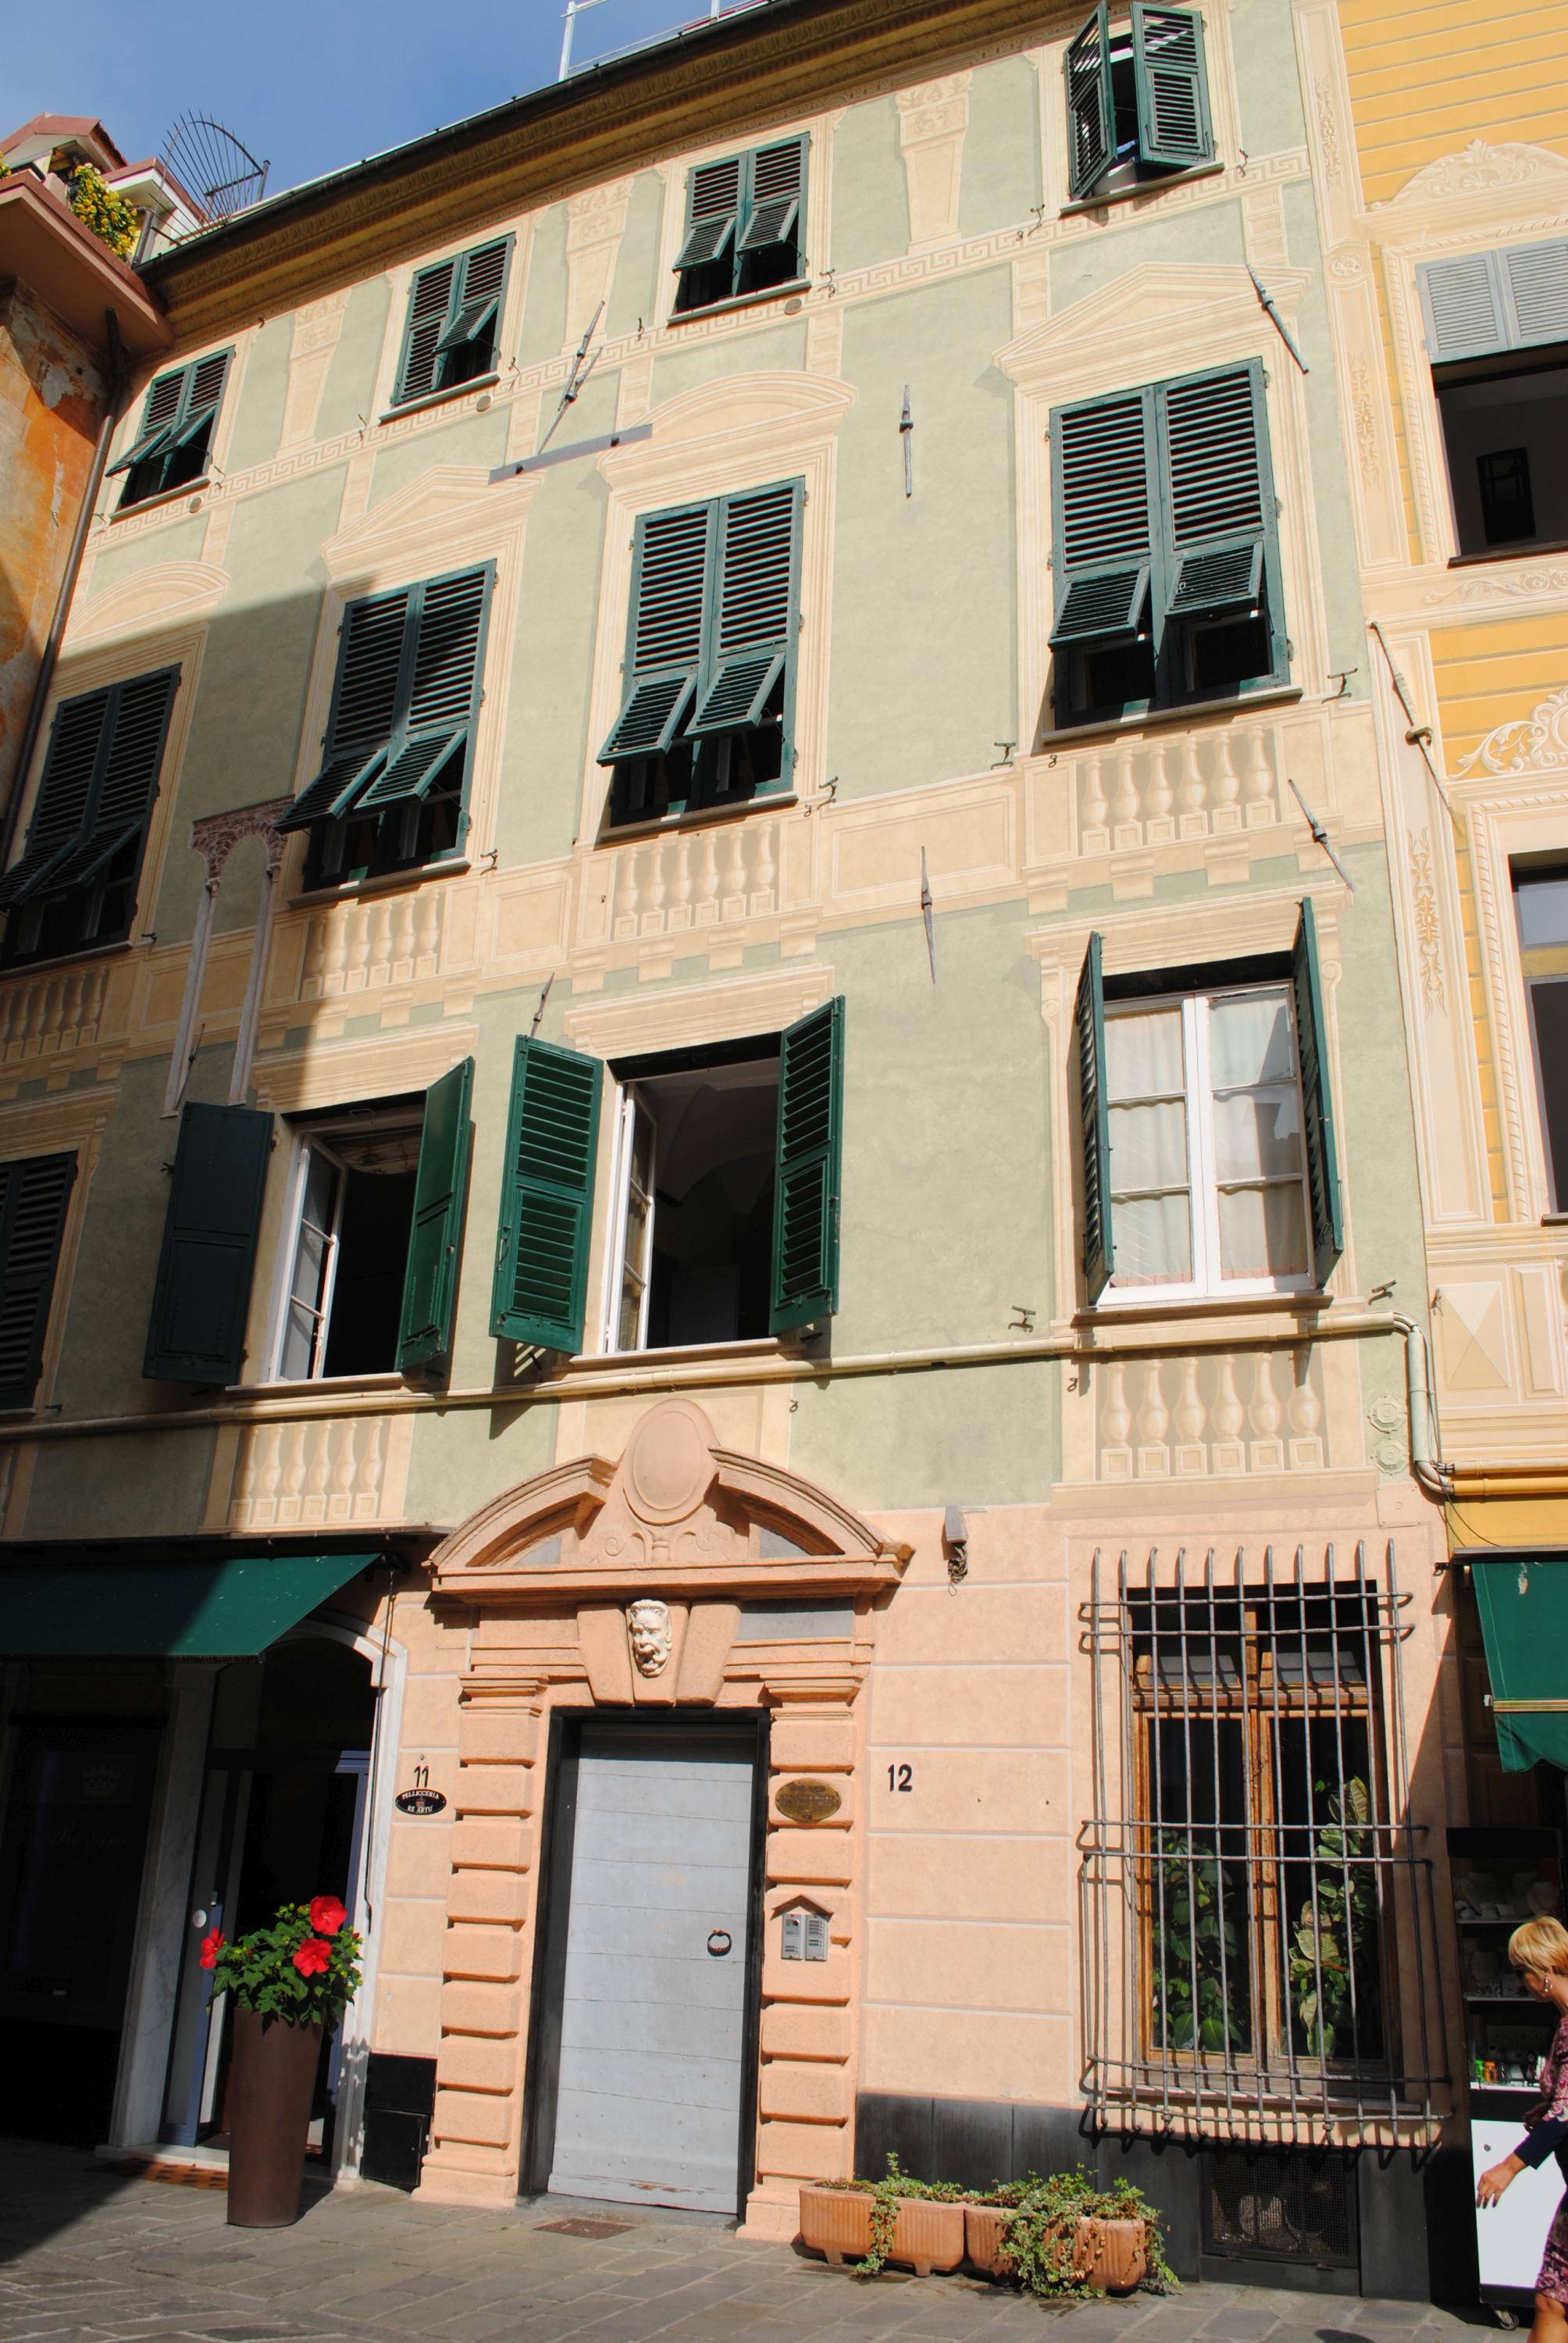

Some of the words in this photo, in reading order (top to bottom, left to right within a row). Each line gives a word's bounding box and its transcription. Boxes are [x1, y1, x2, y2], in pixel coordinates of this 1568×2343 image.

[414, 1765, 429, 1788] 11
[888, 1763, 913, 1792] 12
[401, 1790, 440, 1800] PELLICCERIA
